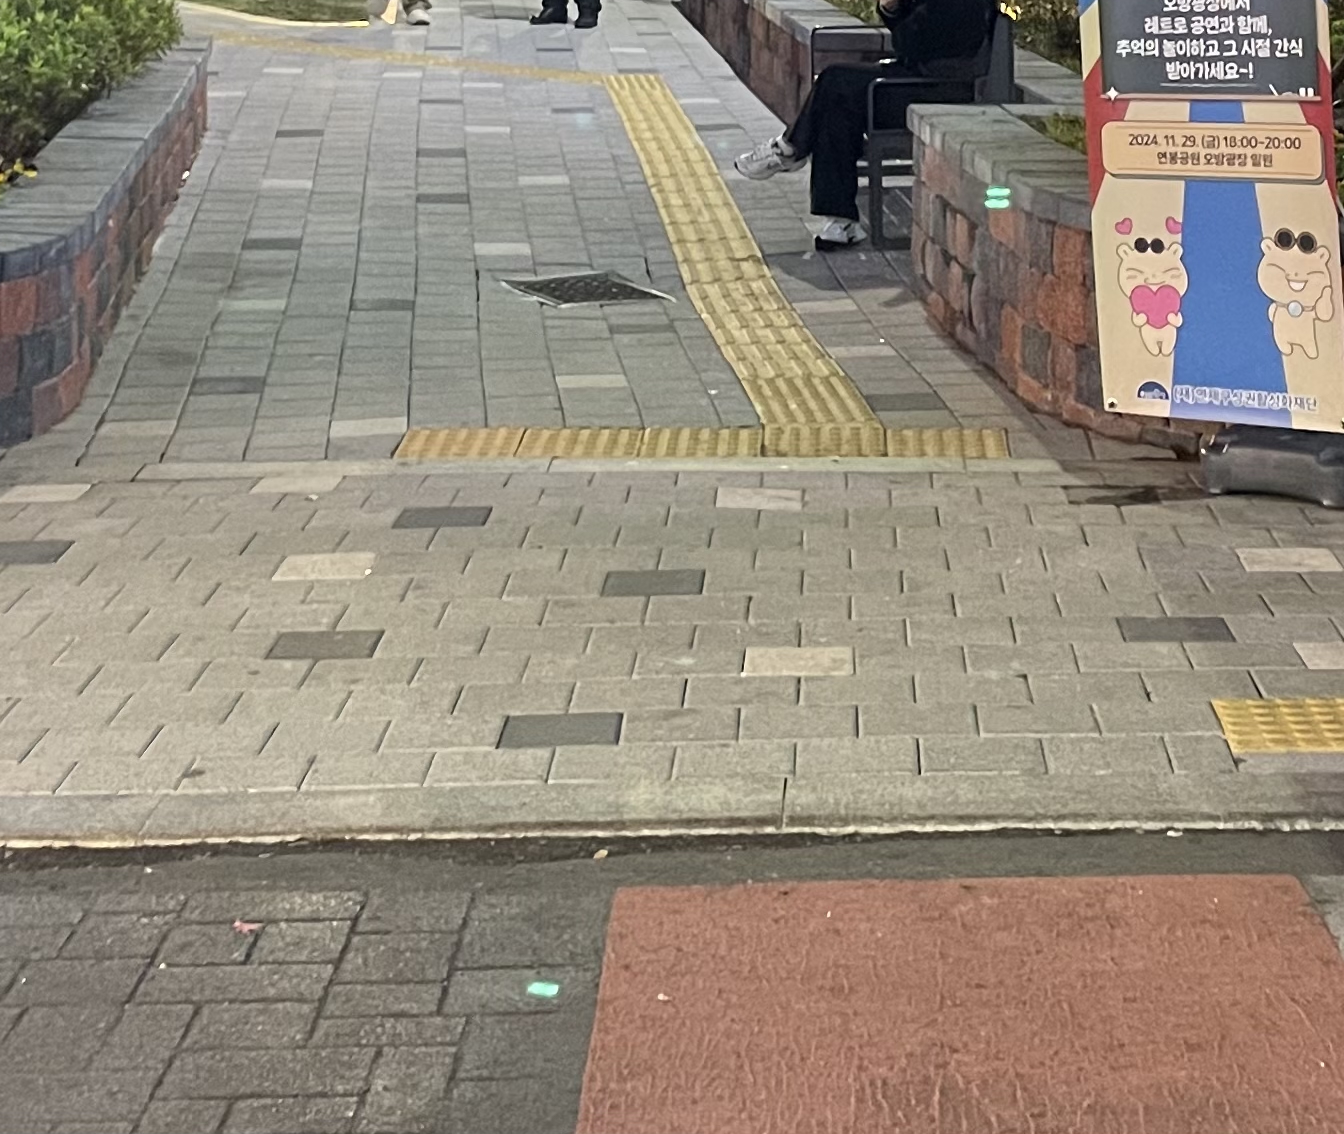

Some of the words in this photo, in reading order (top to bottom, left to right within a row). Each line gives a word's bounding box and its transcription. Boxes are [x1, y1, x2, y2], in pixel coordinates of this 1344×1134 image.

[1144, 16, 1188, 35] 레트로
[1191, 16, 1234, 35] 공연과
[1237, 15, 1273, 36] 함께,
[1116, 39, 1158, 57] 추억의
[1163, 39, 1220, 57] 놀이하고
[1223, 40, 1238, 56] 그
[1241, 39, 1271, 57] 시절
[1273, 38, 1303, 57] 간식
[1129, 134, 1161, 148] 2024.
[1164, 135, 1179, 148] 11.
[1182, 135, 1199, 149] 29.
[1203, 152, 1248, 167] 오방광장
